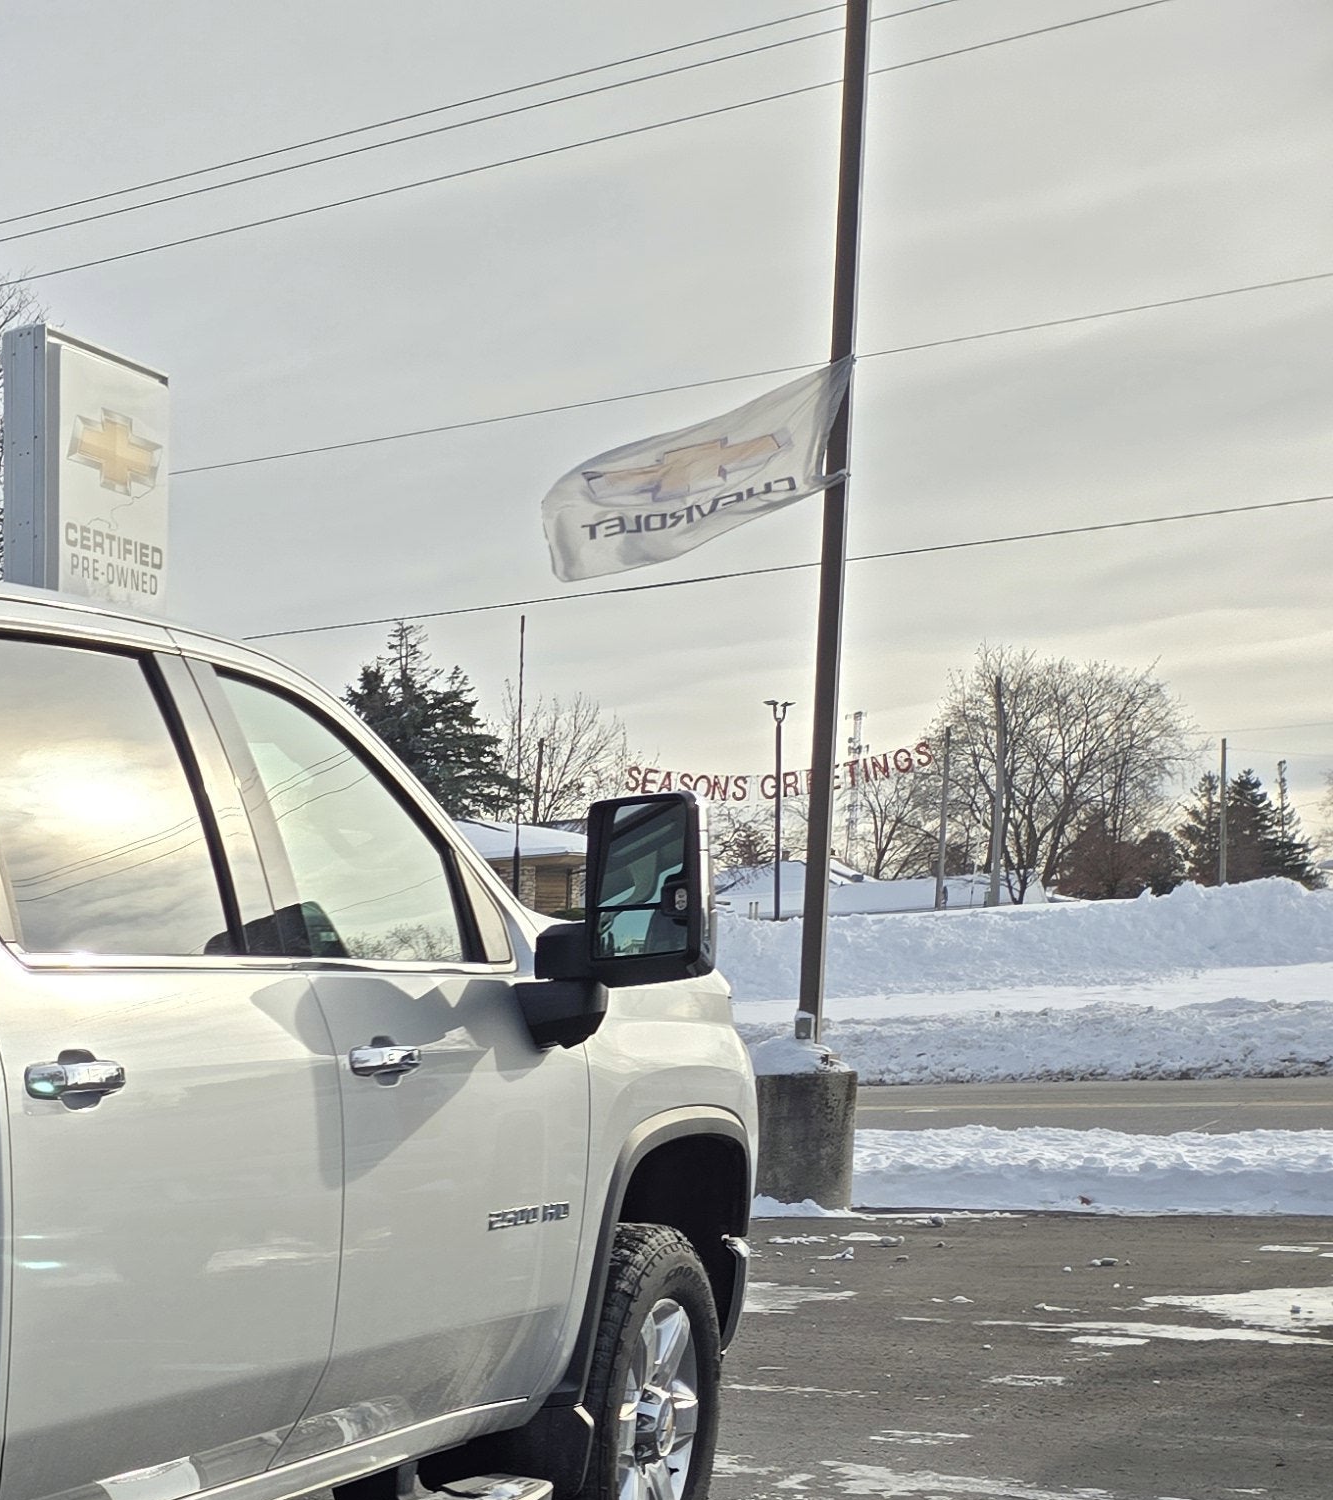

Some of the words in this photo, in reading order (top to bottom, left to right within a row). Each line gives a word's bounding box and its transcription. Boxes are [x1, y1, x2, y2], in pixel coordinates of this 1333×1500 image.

[65, 522, 163, 571] CERTIFIED
[70, 552, 158, 596] PRE-OWNED
[625, 766, 748, 801] SEASONS
[541, 1201, 570, 1222] HD
